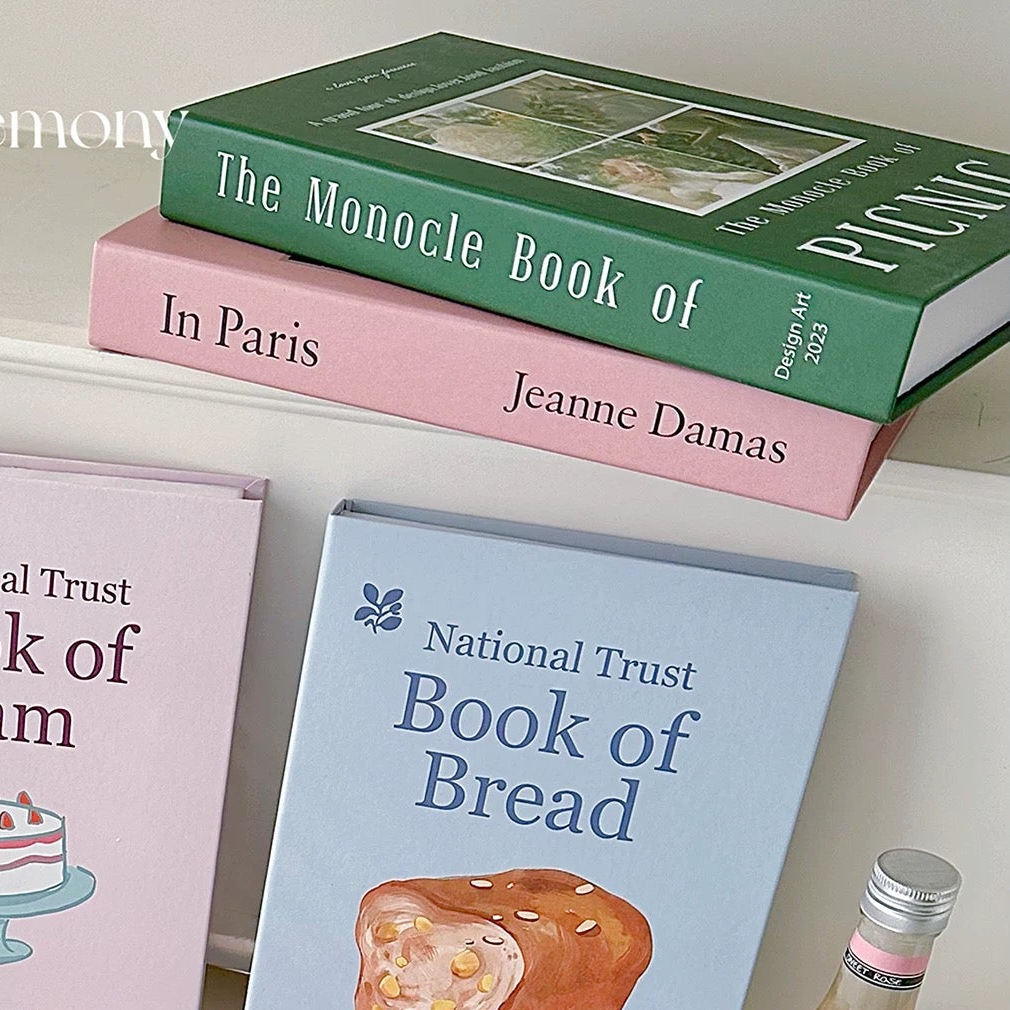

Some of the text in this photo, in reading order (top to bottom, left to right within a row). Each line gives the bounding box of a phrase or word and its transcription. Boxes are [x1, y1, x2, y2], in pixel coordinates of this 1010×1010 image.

[716, 141, 922, 236] The Monocle Book of
[216, 151, 704, 330] The Monocle Book of
[159, 292, 321, 368] In Paris
[774, 290, 812, 381] Design Art
[804, 322, 829, 365] 2023
[503, 370, 788, 467] Jeanne Damas
[40, 567, 132, 606] Trust
[65, 623, 141, 685] of
[423, 621, 698, 691] National Trust
[393, 670, 701, 774] Book of
[415, 750, 640, 843] Bread
